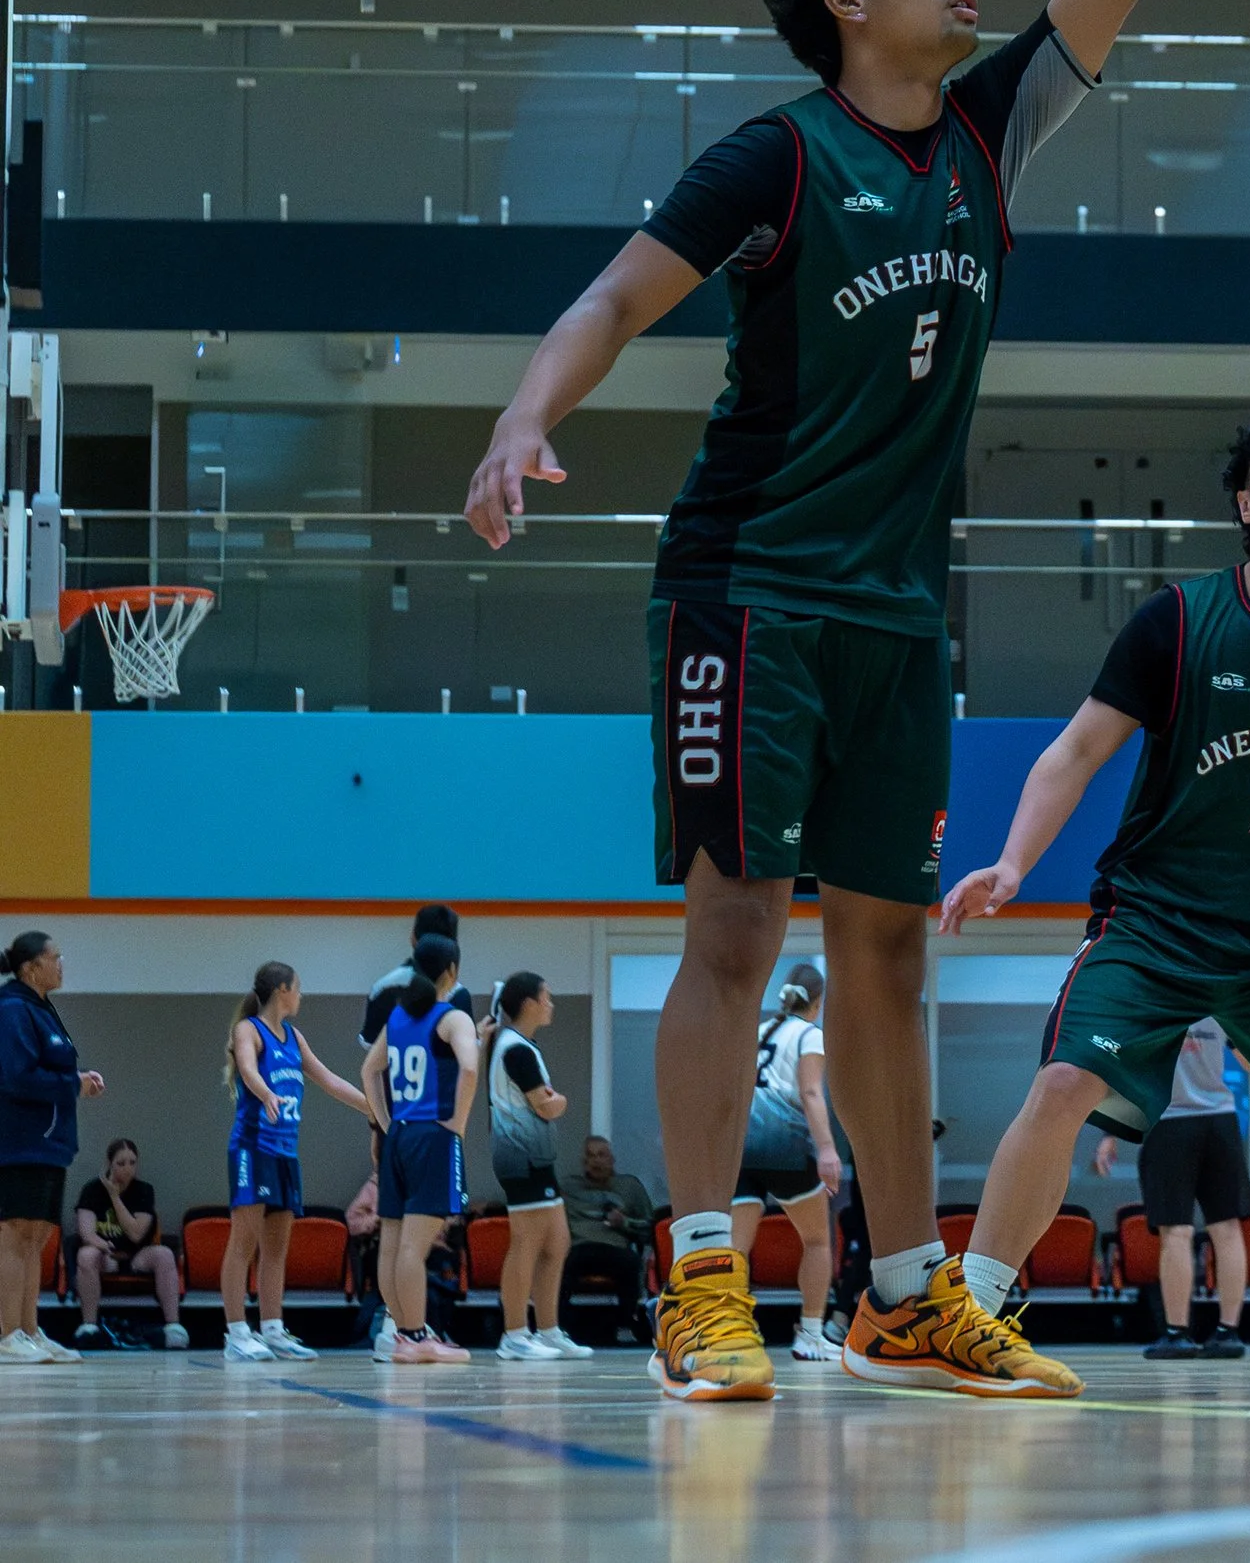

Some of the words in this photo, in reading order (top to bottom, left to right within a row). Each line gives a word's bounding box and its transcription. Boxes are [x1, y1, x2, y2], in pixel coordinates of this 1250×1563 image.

[909, 309, 940, 382] 5
[678, 653, 726, 785] OHS
[387, 1044, 427, 1103] 29
